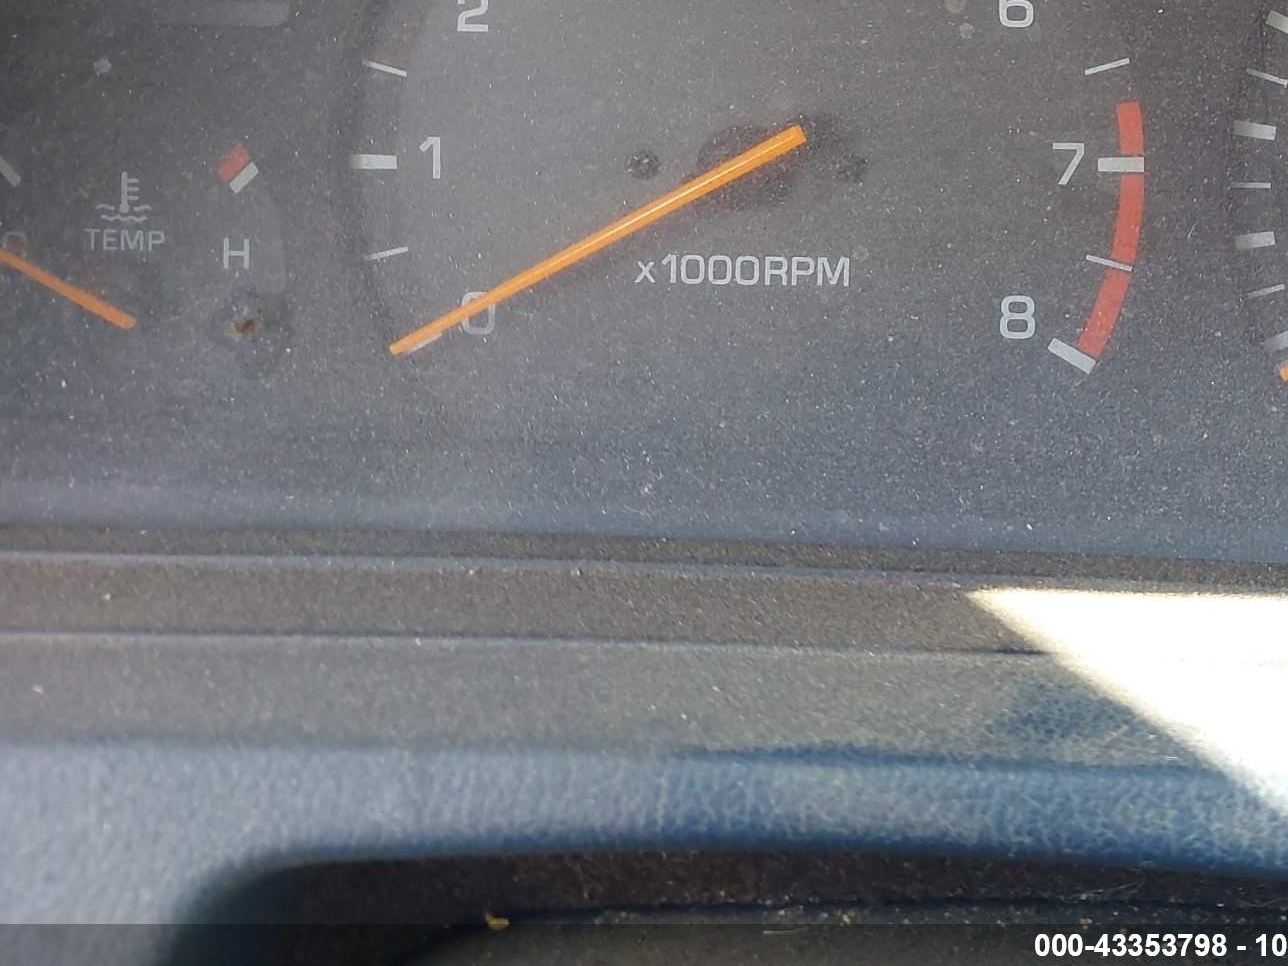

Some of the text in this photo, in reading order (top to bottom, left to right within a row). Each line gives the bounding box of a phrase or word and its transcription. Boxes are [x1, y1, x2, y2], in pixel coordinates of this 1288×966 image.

[419, 137, 441, 178] 1
[1052, 142, 1085, 185] 7
[85, 229, 166, 252] TEMP
[223, 239, 251, 269] H
[635, 255, 850, 286] x1000RPM
[461, 292, 497, 334] 0
[1000, 296, 1036, 339] 8
